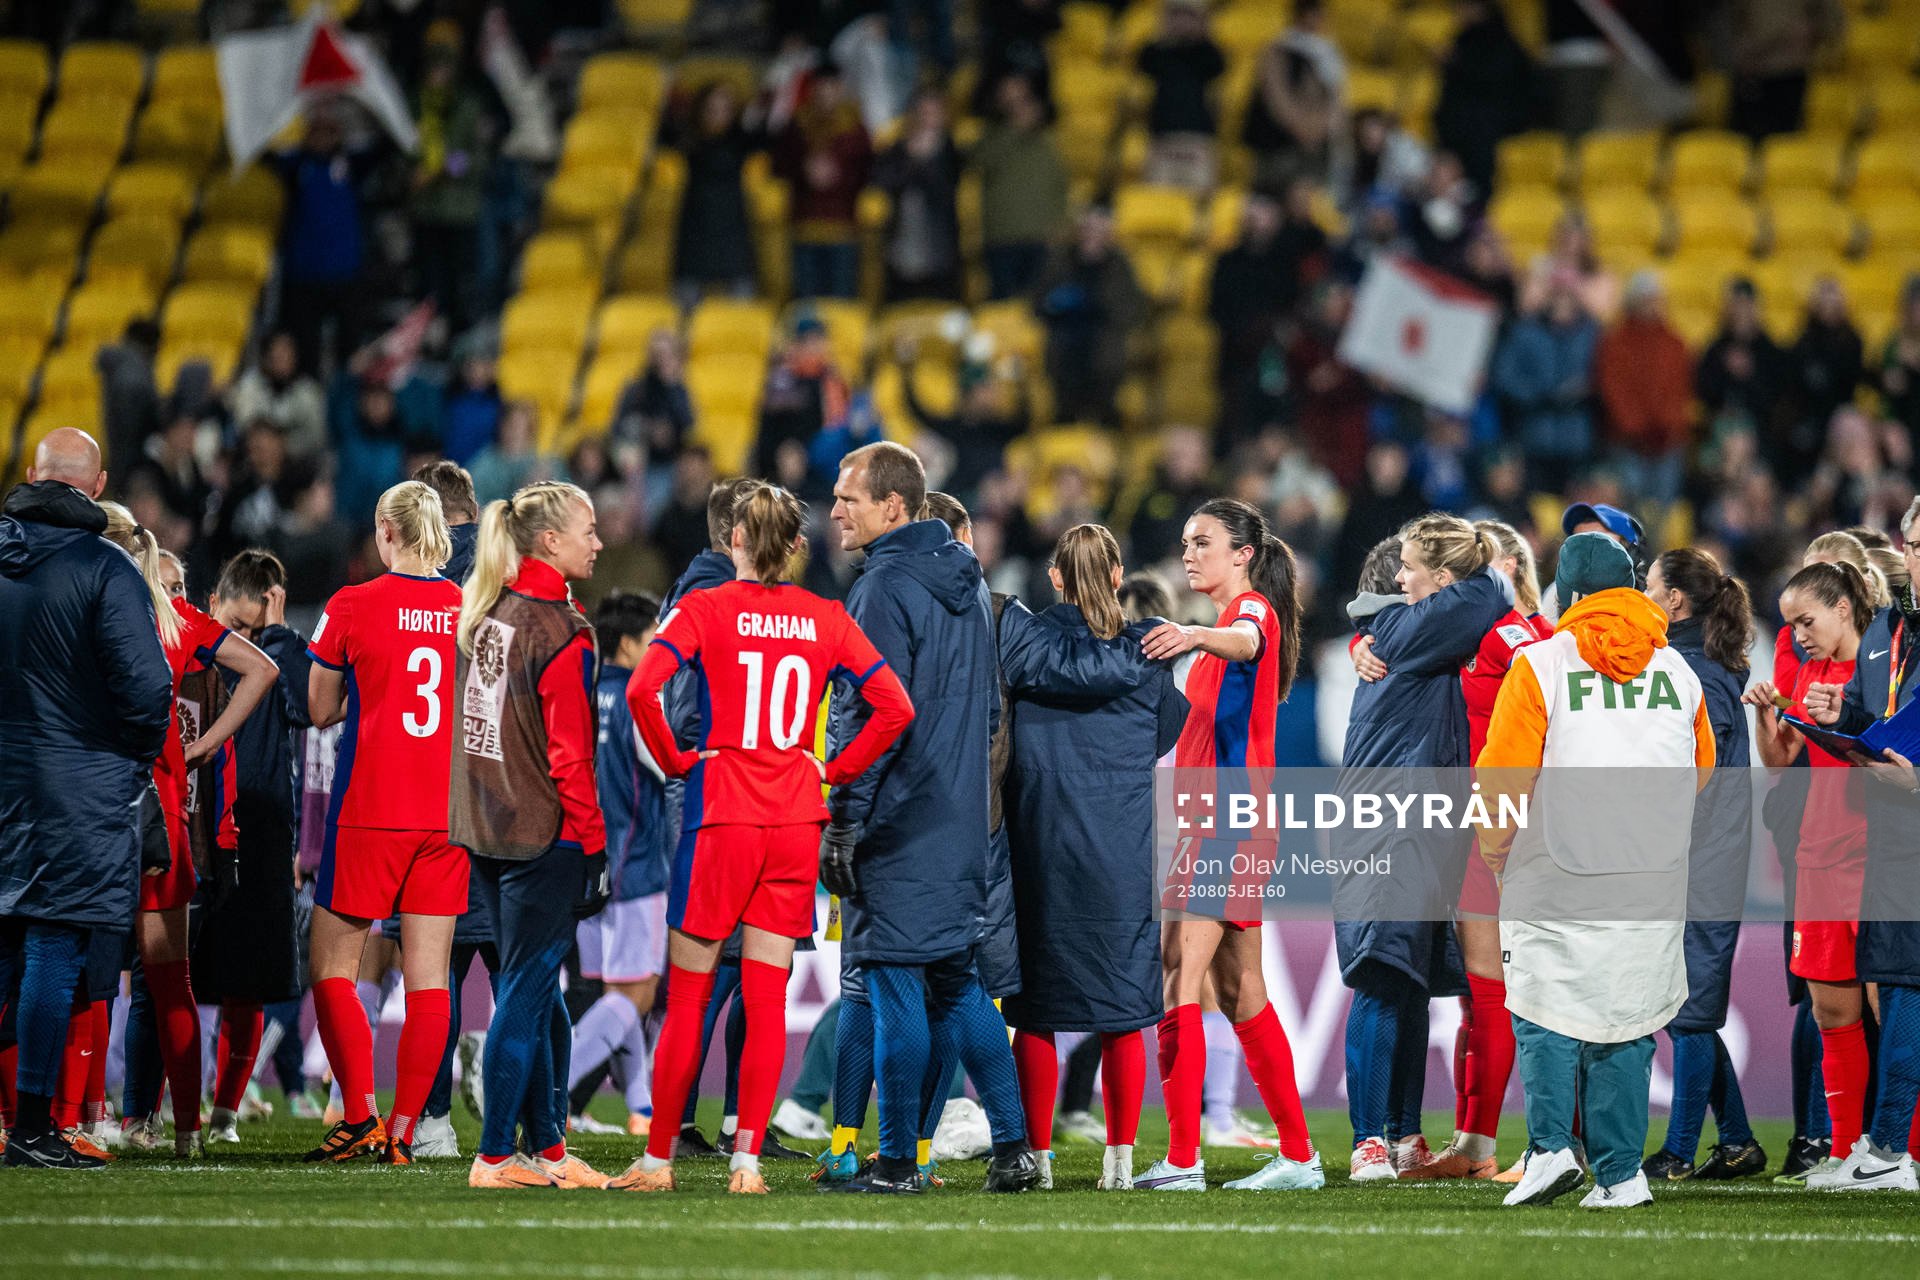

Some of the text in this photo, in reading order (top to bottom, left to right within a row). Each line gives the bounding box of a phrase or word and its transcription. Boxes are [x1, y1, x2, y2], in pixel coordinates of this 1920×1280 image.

[398, 607, 454, 635] HØRTE
[737, 611, 817, 642] GRAHAM
[402, 646, 442, 738] 3
[738, 650, 811, 750] 10
[1567, 670, 1682, 711] FIFA
